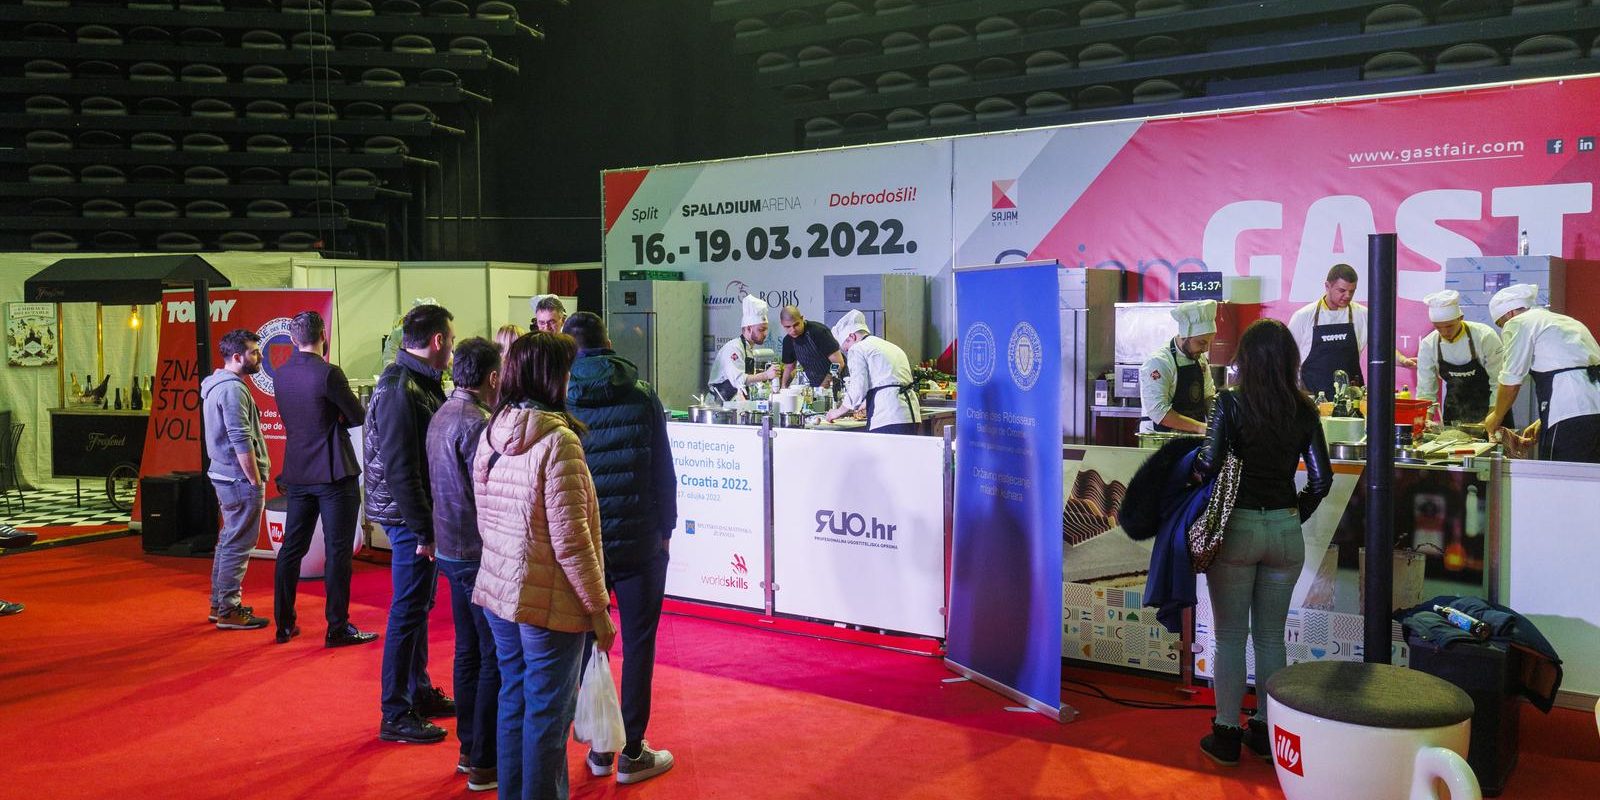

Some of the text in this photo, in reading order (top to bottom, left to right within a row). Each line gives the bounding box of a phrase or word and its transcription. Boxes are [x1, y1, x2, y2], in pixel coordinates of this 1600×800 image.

[1349, 139, 1525, 163] www.gastfair.com
[632, 207, 659, 223] Split
[829, 186, 917, 207] Dobrodošli!
[991, 211, 1018, 222] SAJAM
[1202, 182, 1593, 305] GAST
[1180, 281, 1220, 291] 1:54:37
[167, 299, 237, 324] TOMY
[1321, 333, 1347, 341] TOMMY
[687, 440, 735, 454] natjecanje
[716, 457, 741, 470] škola
[681, 474, 752, 492] Croatia 2022.
[1277, 734, 1300, 768] illy
